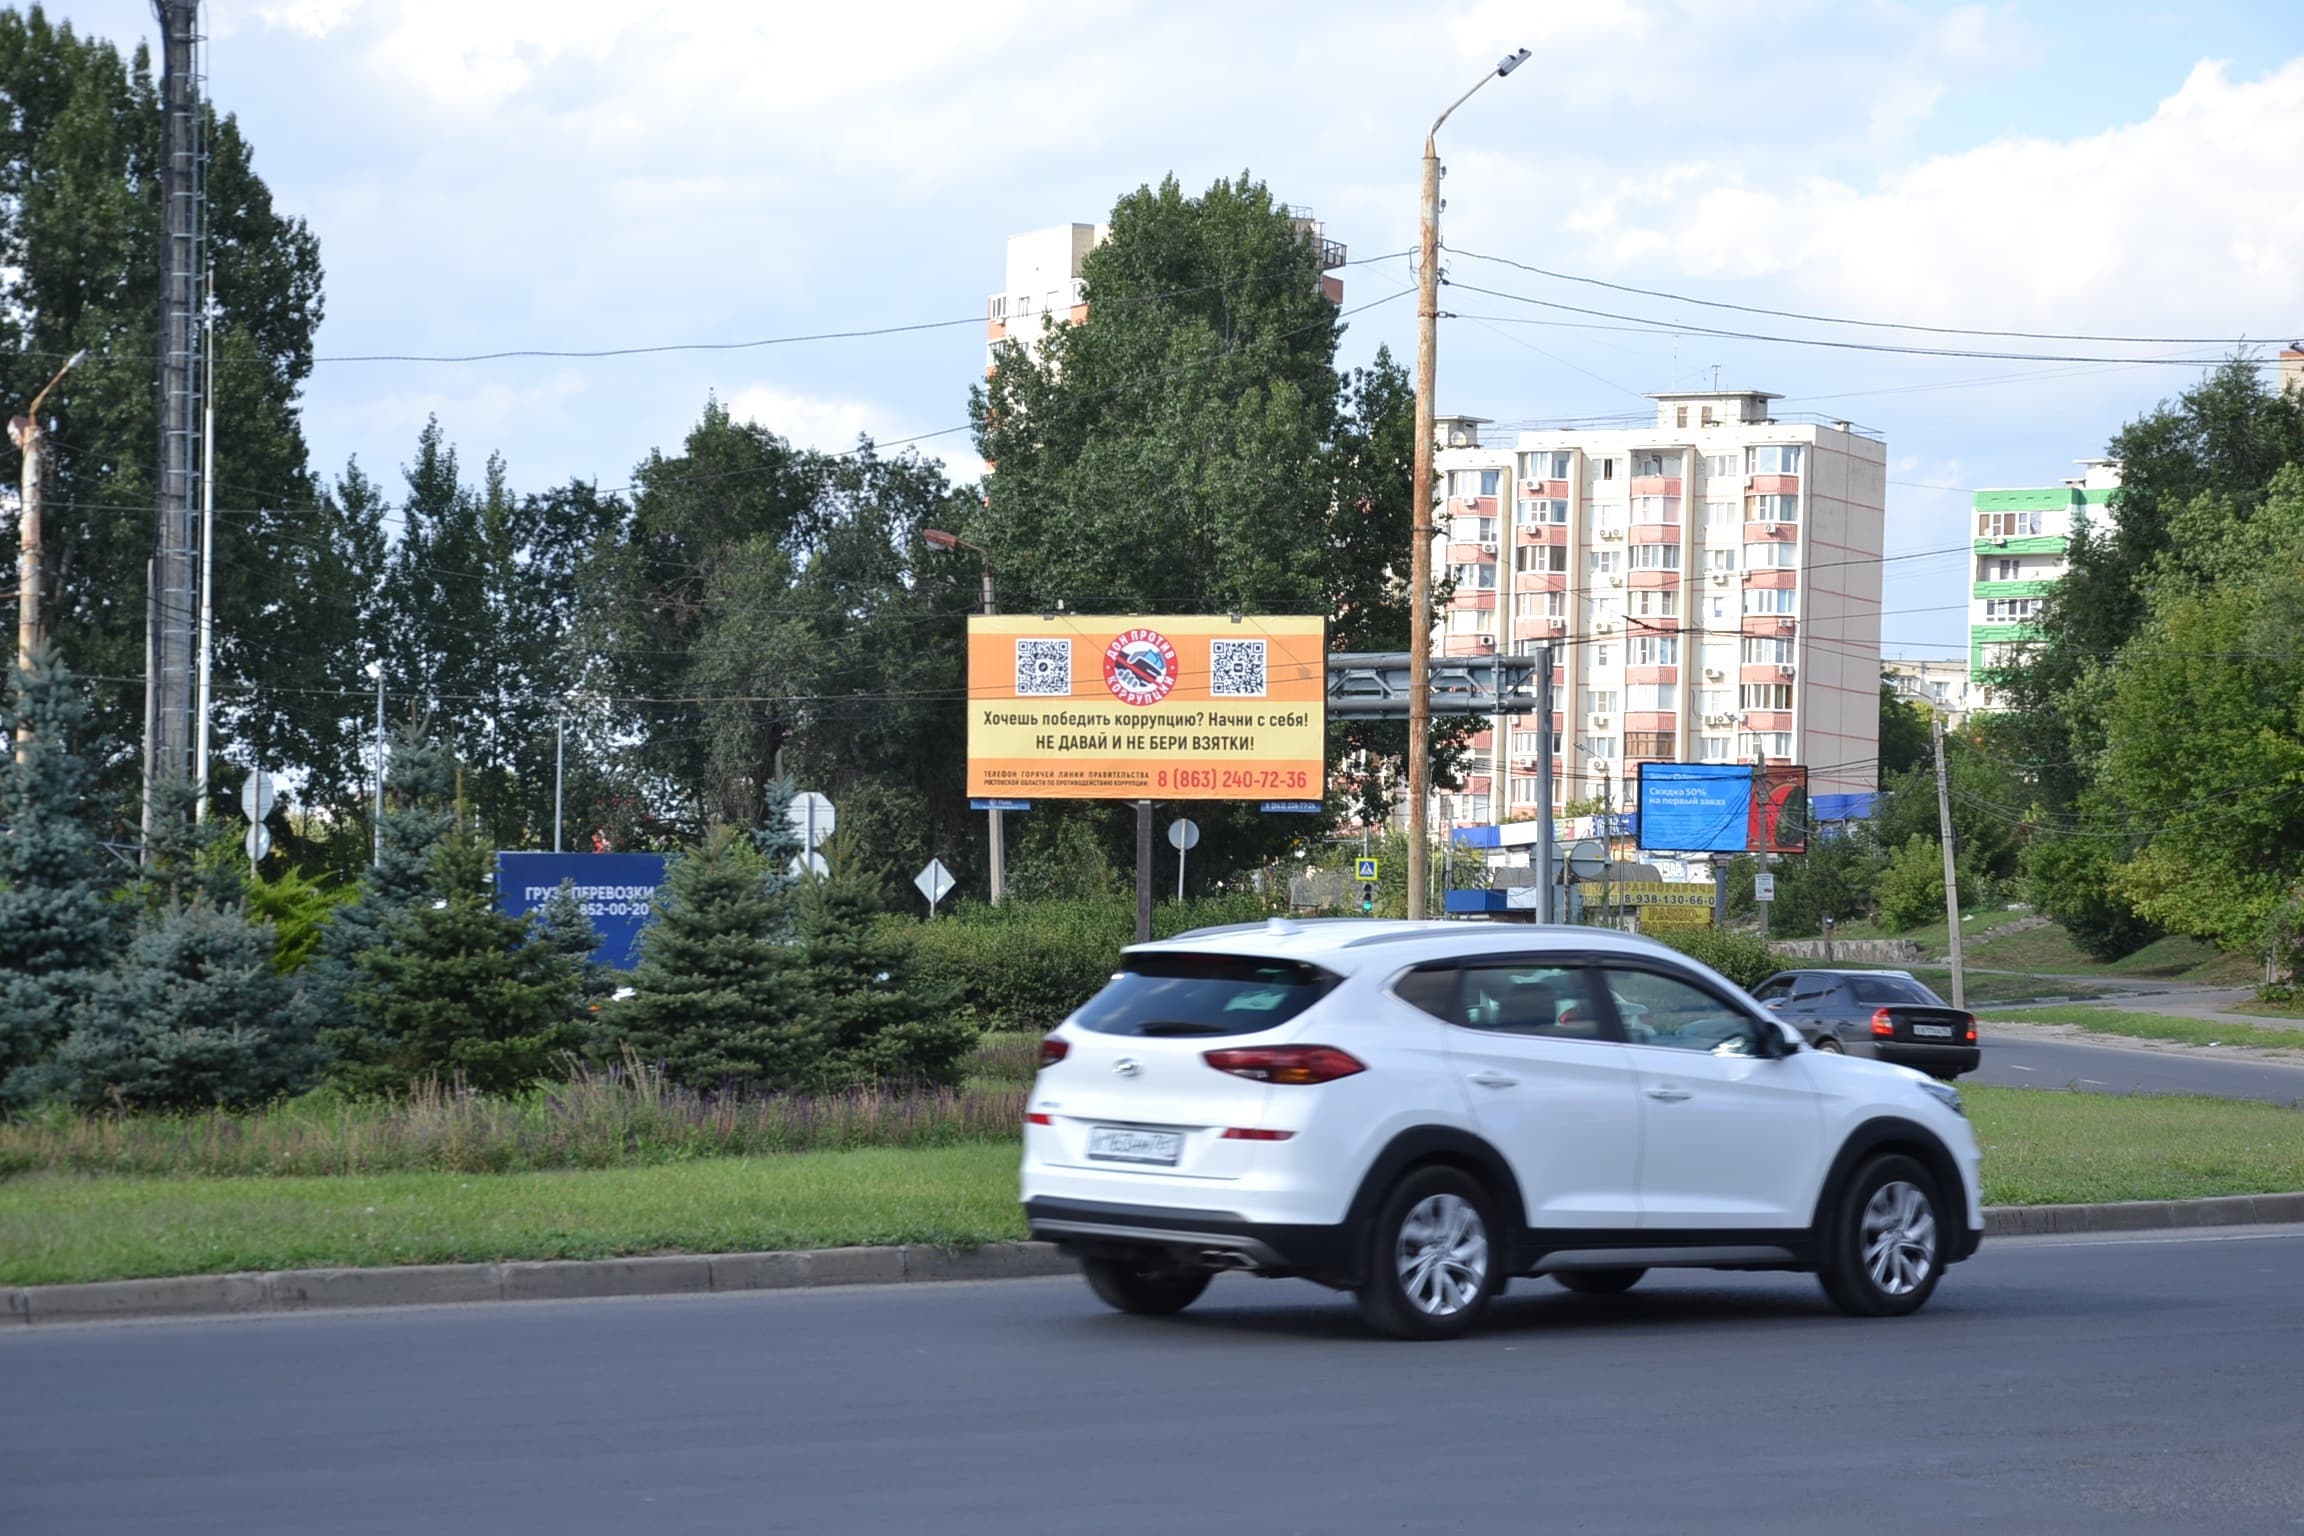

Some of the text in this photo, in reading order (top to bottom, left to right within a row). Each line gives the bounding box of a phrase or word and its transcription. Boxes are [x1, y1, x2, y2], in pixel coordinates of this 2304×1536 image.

[1106, 630, 1175, 660] ДОН ПРОТИВ
[1107, 676, 1175, 704] КОРРУПЦИИ
[984, 711, 1308, 728] Хочешь победить коррупцию? Начни с себя!
[1036, 732, 1254, 751] НЕ ДАВАЙ И НЕ БЕРИ ВЗЯТКИ!
[984, 770, 1017, 778] ТЕЛЕФОН
[1021, 770, 1054, 778] ГОРЯЧЕЙ
[1158, 768, 1307, 789] 8 (863) 240-72-36
[1649, 787, 1707, 797] Скидка 50%
[1662, 797, 1698, 806] первый
[525, 886, 655, 900] ГРУЗПЕРЕВОЗКИ
[1624, 883, 1715, 893] РАЗНОРАБОЧИ
[1624, 894, 1715, 905] 8-938-130-66-0
